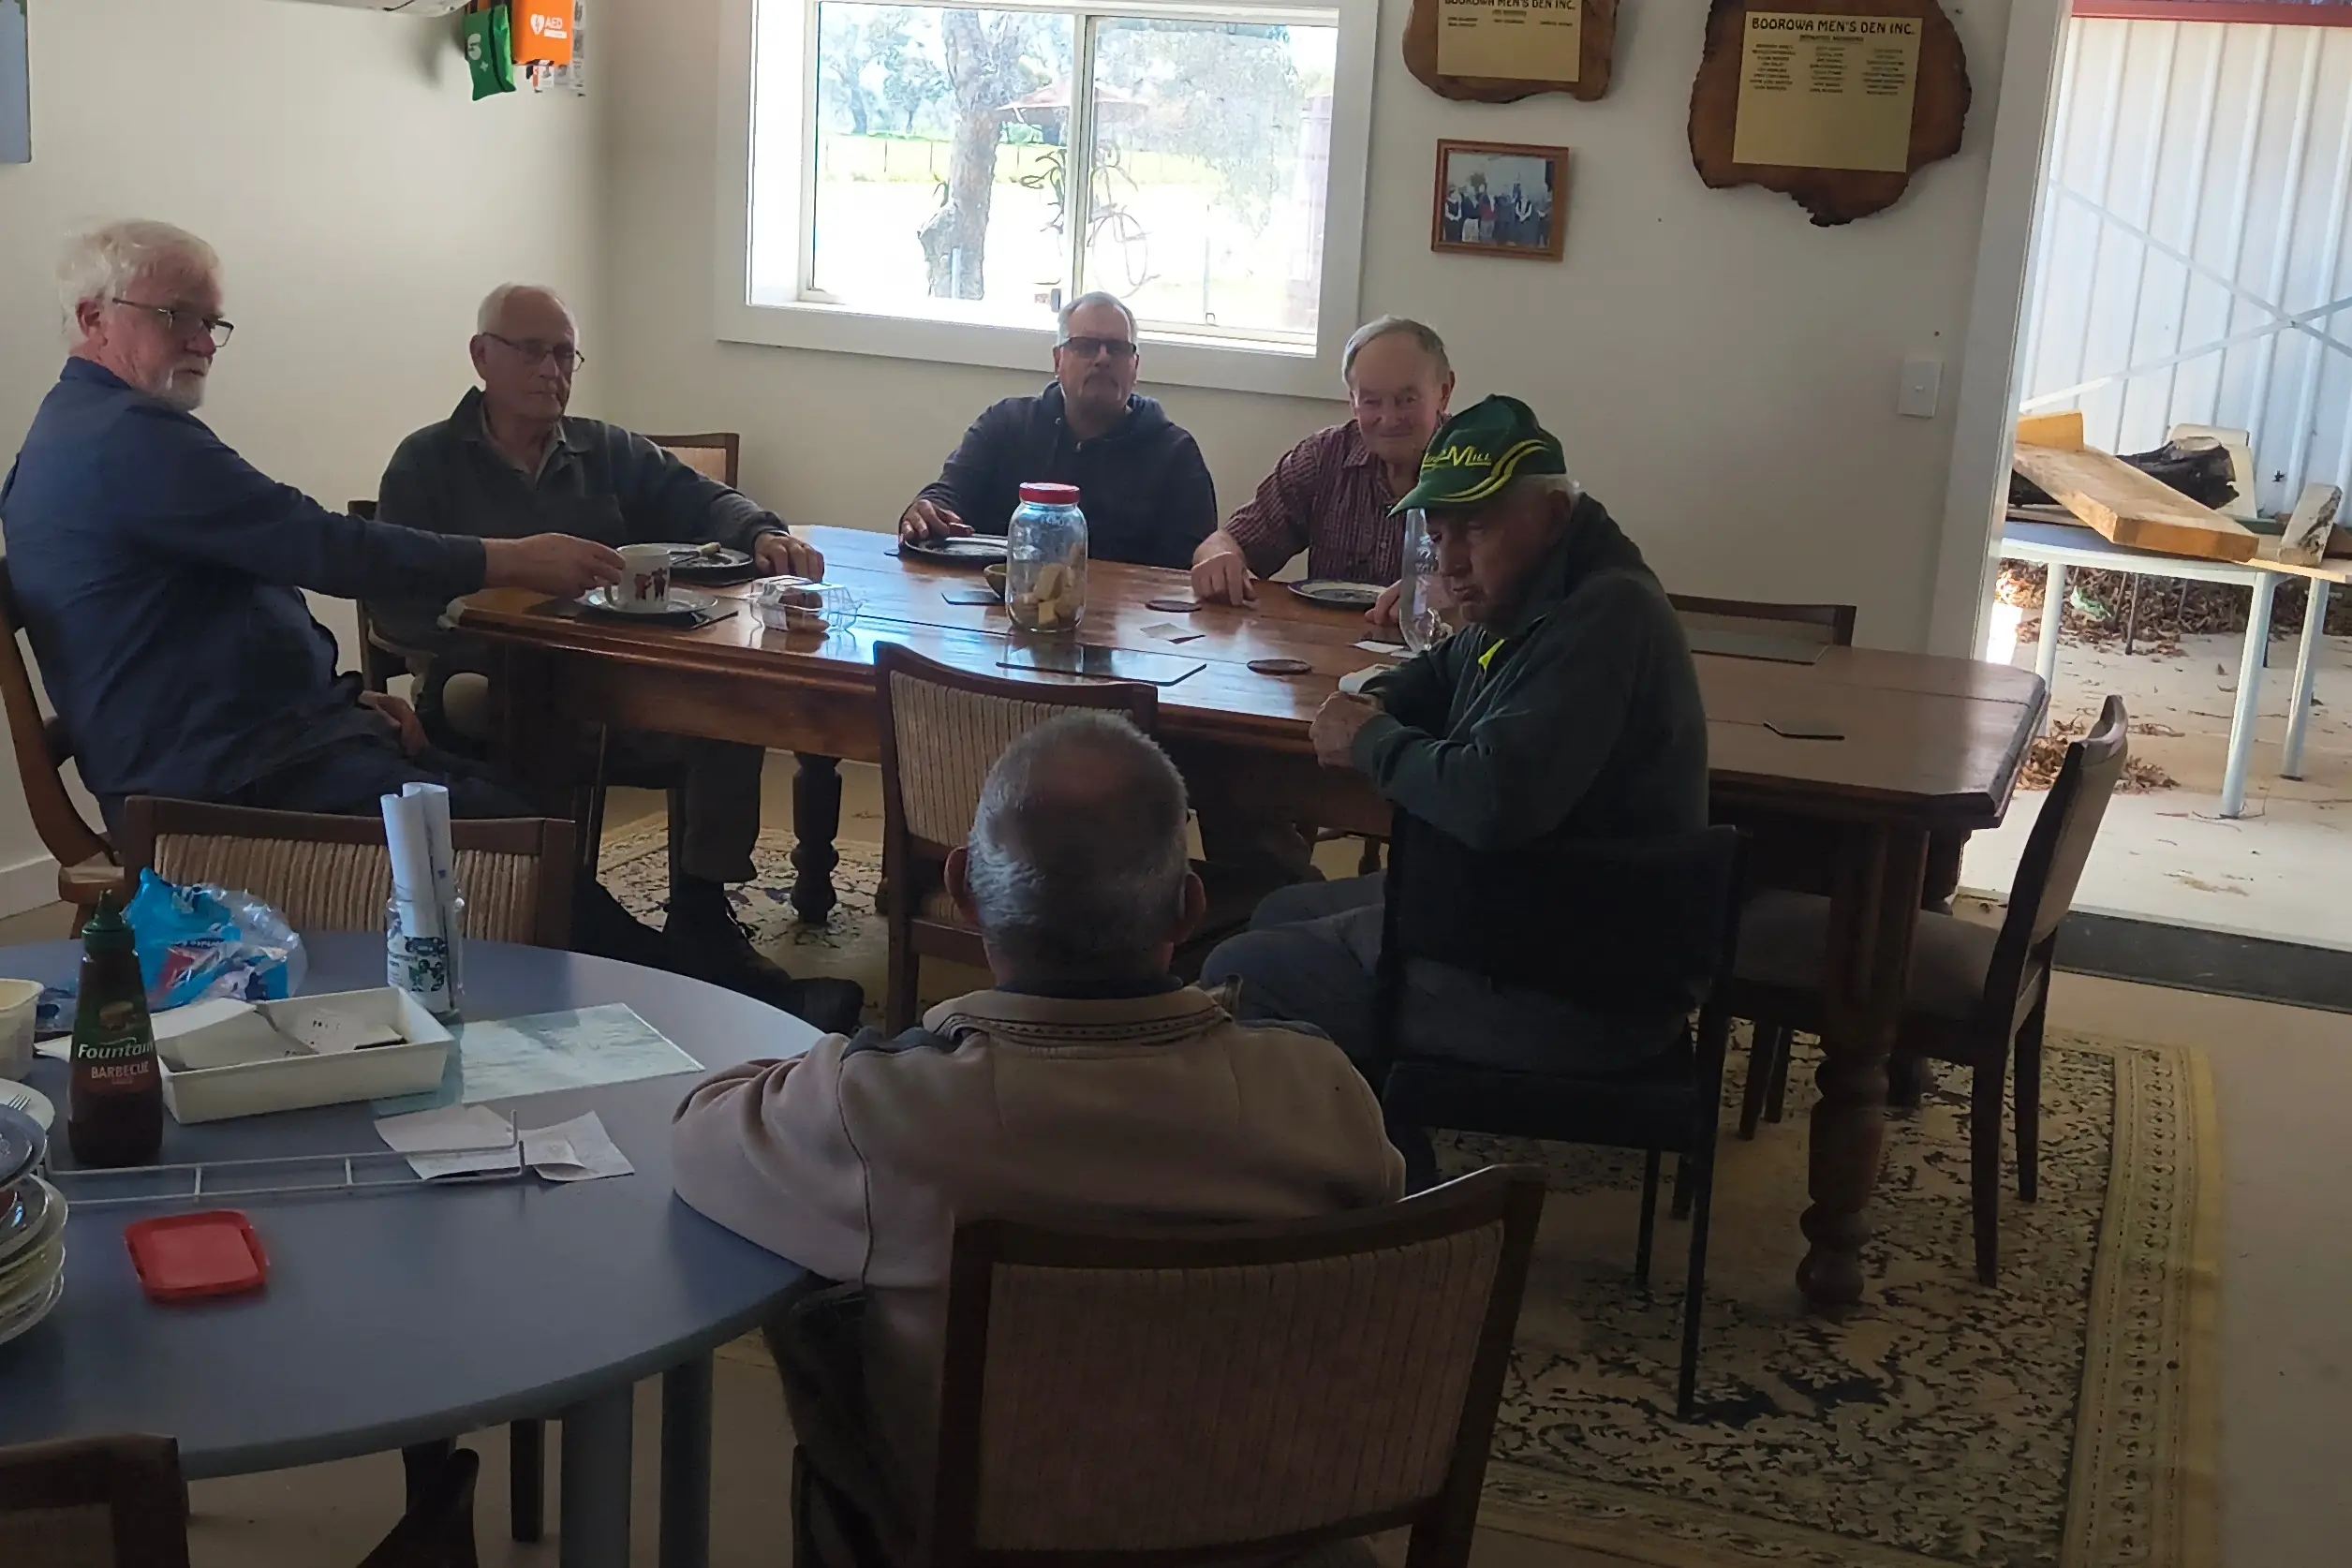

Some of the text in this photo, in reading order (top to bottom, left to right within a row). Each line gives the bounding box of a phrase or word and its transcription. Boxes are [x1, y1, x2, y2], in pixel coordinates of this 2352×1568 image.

[1532, 0, 1551, 8] DEN
[544, 16, 563, 29] AED
[1752, 17, 1916, 36] BOOROWA MEN'S DEN INC.
[78, 1040, 154, 1059] Fountain
[91, 1060, 149, 1079] BARBECUE
